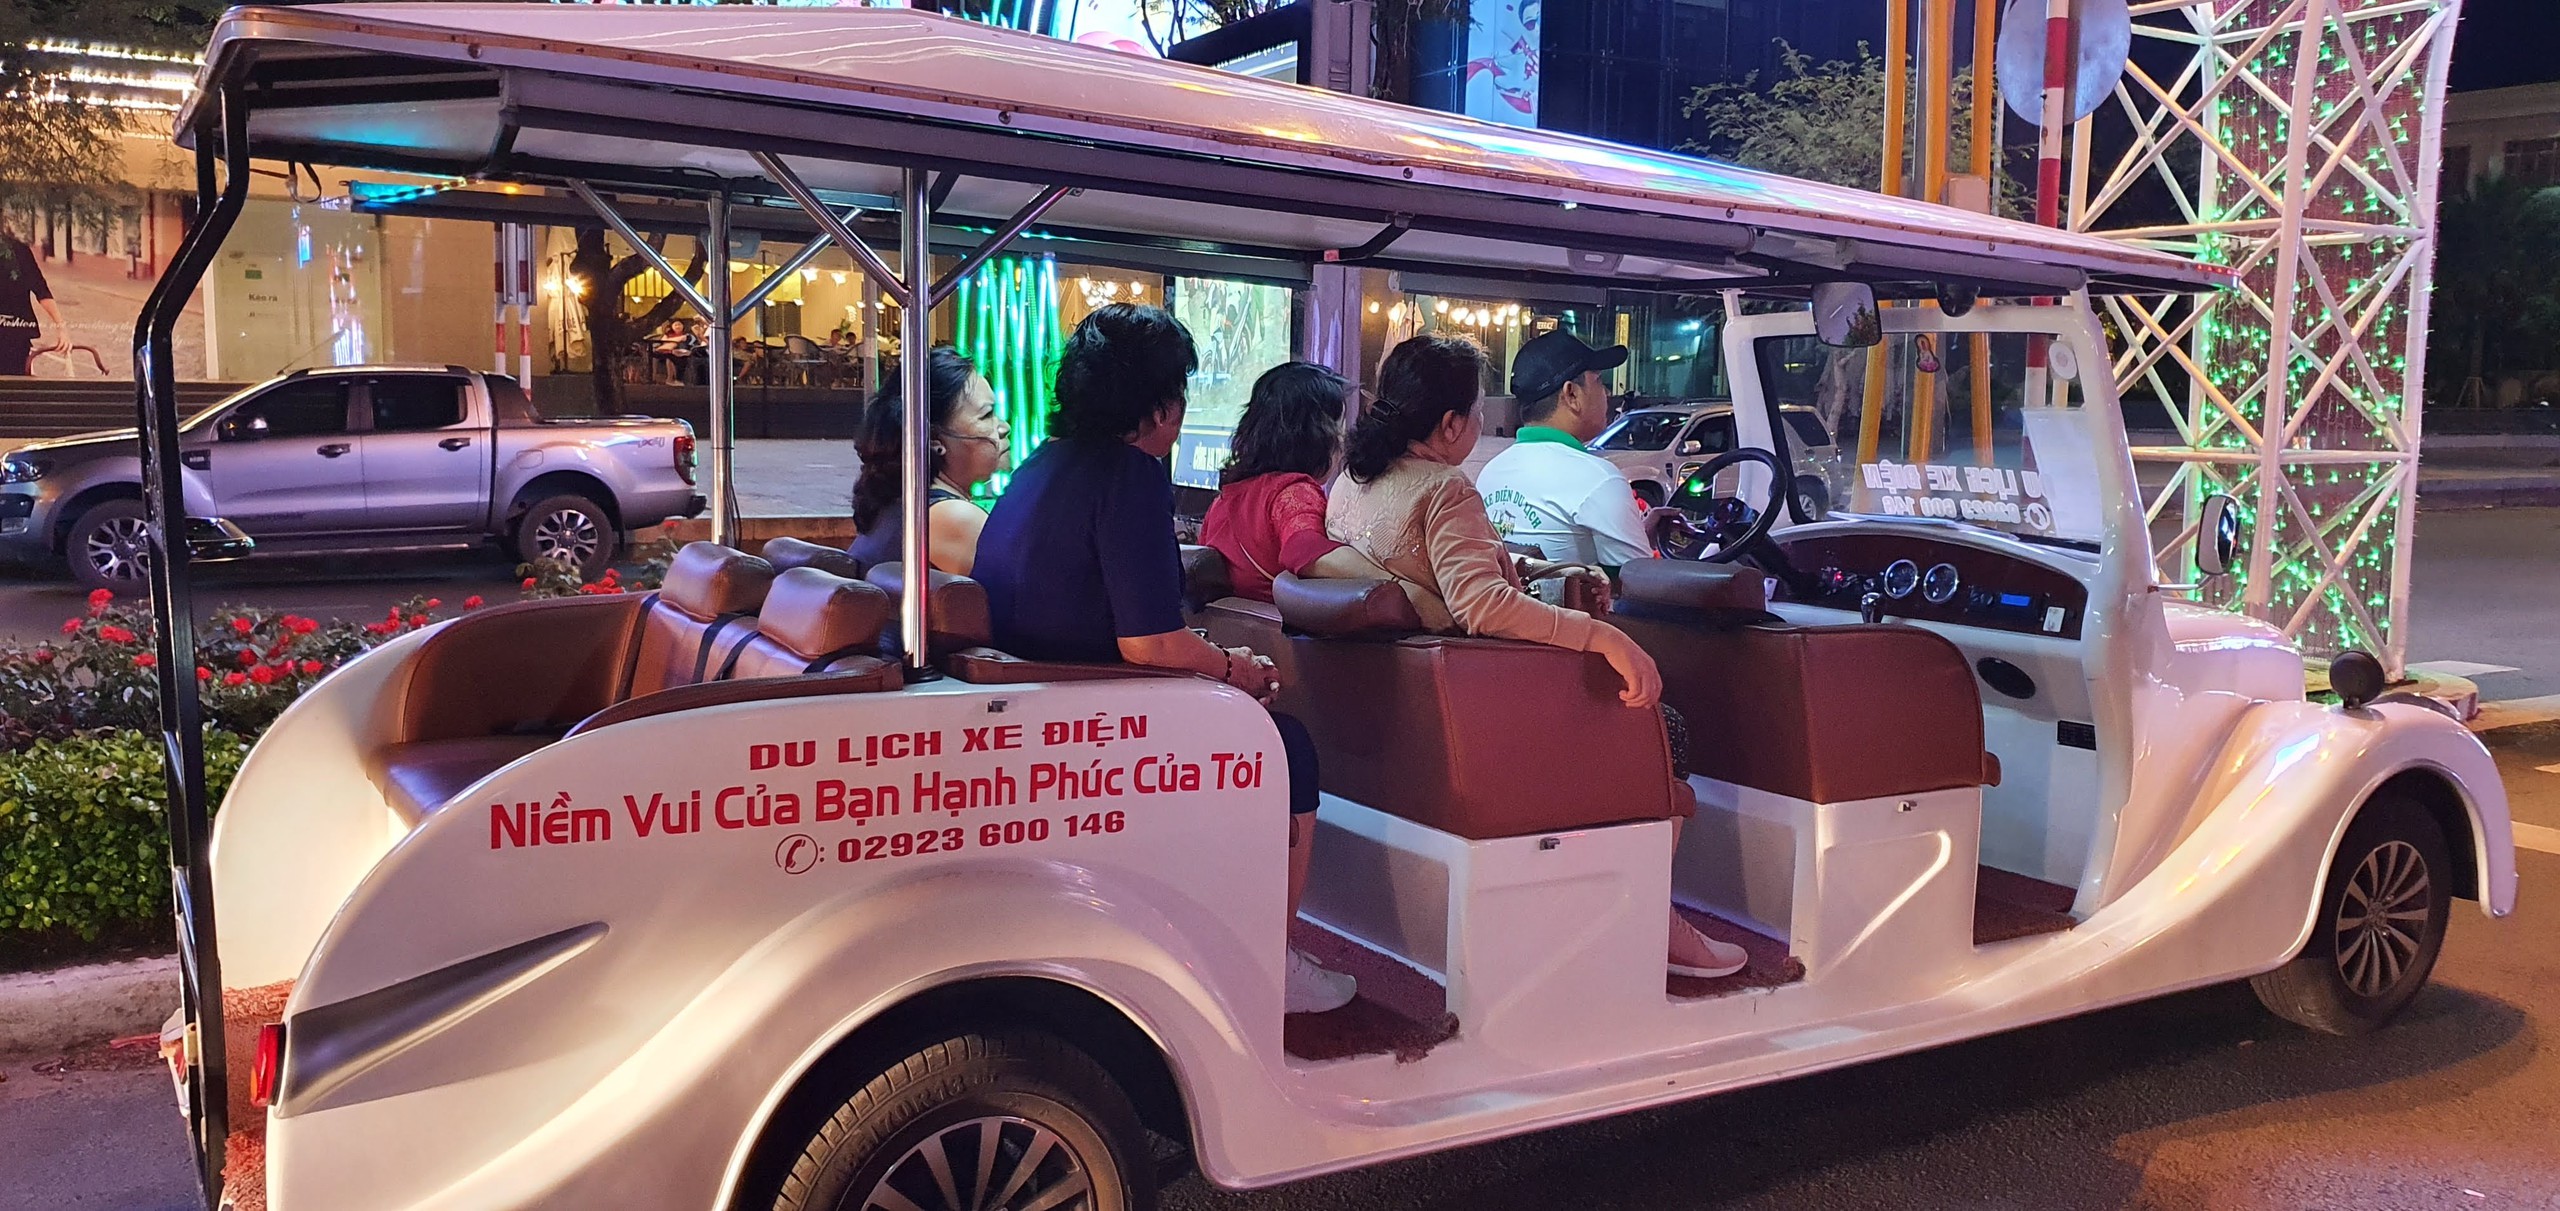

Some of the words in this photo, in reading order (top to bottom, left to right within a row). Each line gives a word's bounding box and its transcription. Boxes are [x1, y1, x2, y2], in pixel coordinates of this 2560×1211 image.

[1513, 491, 1526, 507] DU
[750, 740, 816, 770] DU
[838, 730, 942, 767] LỊCH
[961, 724, 1023, 753] XE
[1041, 712, 1148, 748] ĐIỆN
[490, 791, 611, 850] Niềm
[623, 790, 701, 838] Vui
[714, 783, 800, 829] Của
[815, 779, 899, 827] Bạn
[913, 766, 1016, 818] Hạnh
[1029, 759, 1124, 803] Phúc
[1133, 753, 1200, 794] Của
[837, 827, 965, 863] 02923
[978, 818, 1050, 847] 600
[1063, 810, 1125, 838] 146
